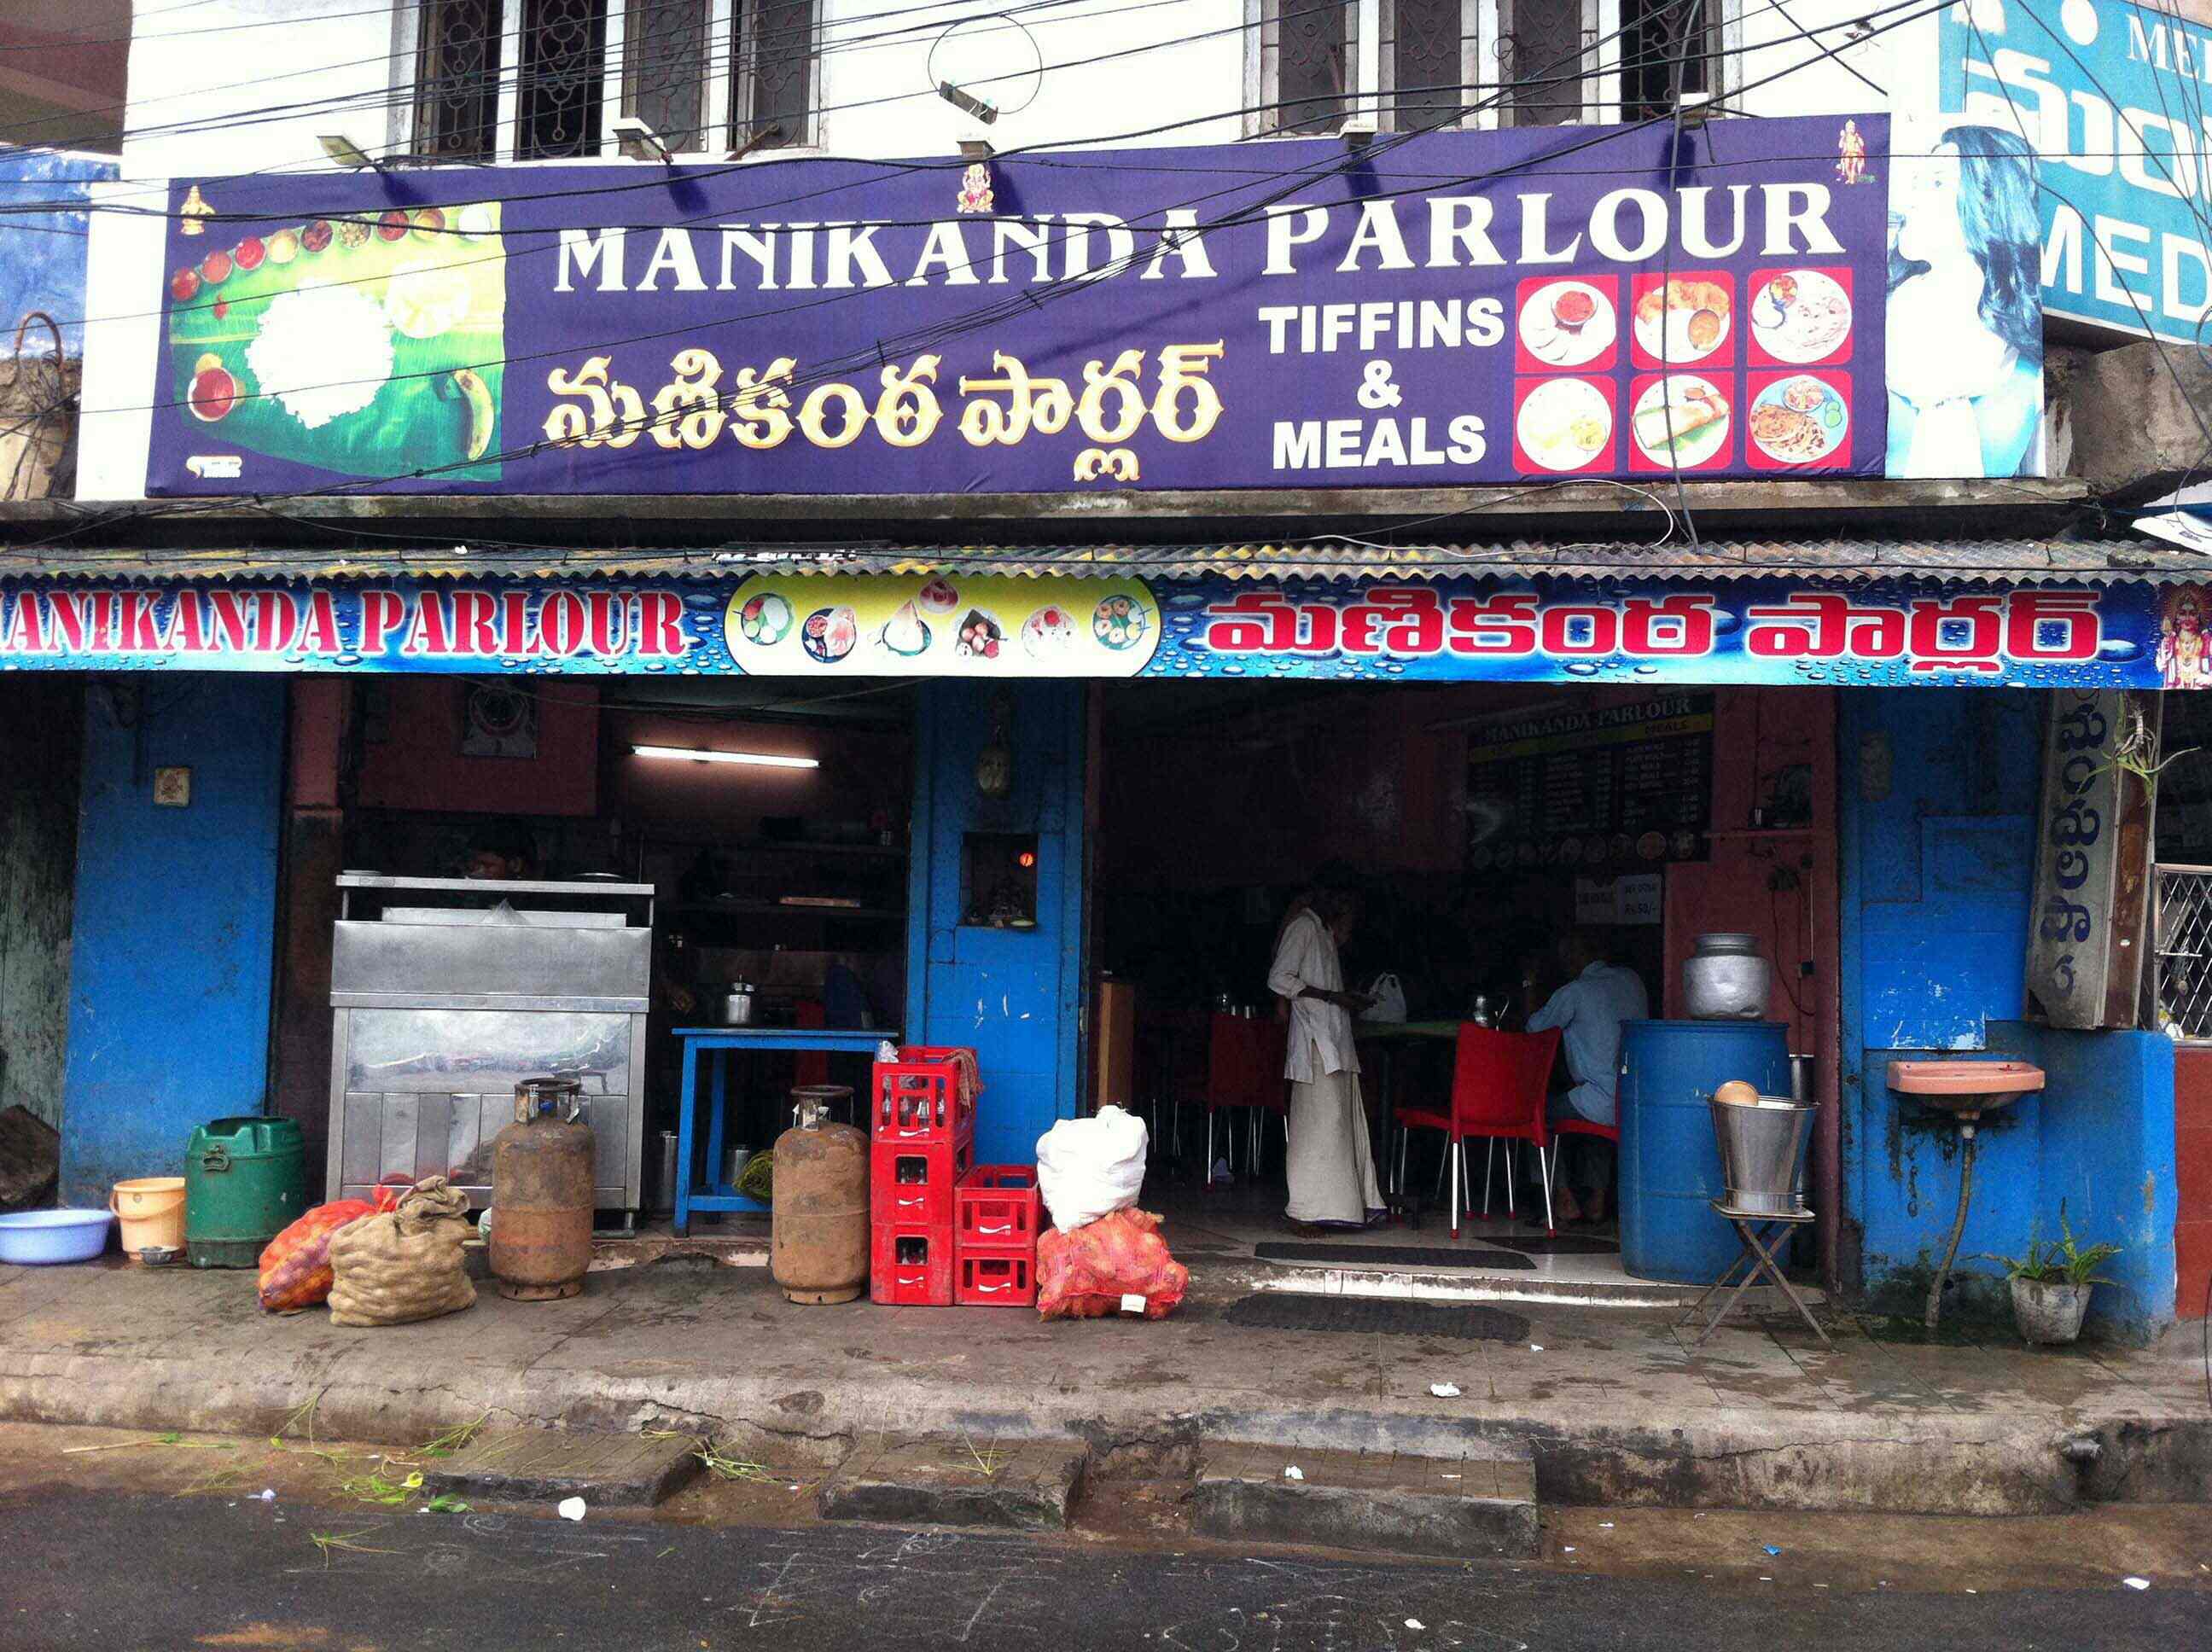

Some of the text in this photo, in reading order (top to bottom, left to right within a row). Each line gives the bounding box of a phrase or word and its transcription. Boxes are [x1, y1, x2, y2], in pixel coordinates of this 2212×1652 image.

[553, 183, 1847, 292] MANIKANDA PARLOUR
[1258, 298, 1505, 354] TIFFINS
[958, 338, 1225, 482] పార్లర్
[1357, 359, 1402, 409] &
[1272, 415, 1487, 469] MEALS
[0, 590, 686, 655] ANIKANDA PARLOUR
[1208, 588, 2099, 672] మణికంఠ పార్లర్
[1598, 697, 1692, 726] PARLOUR
